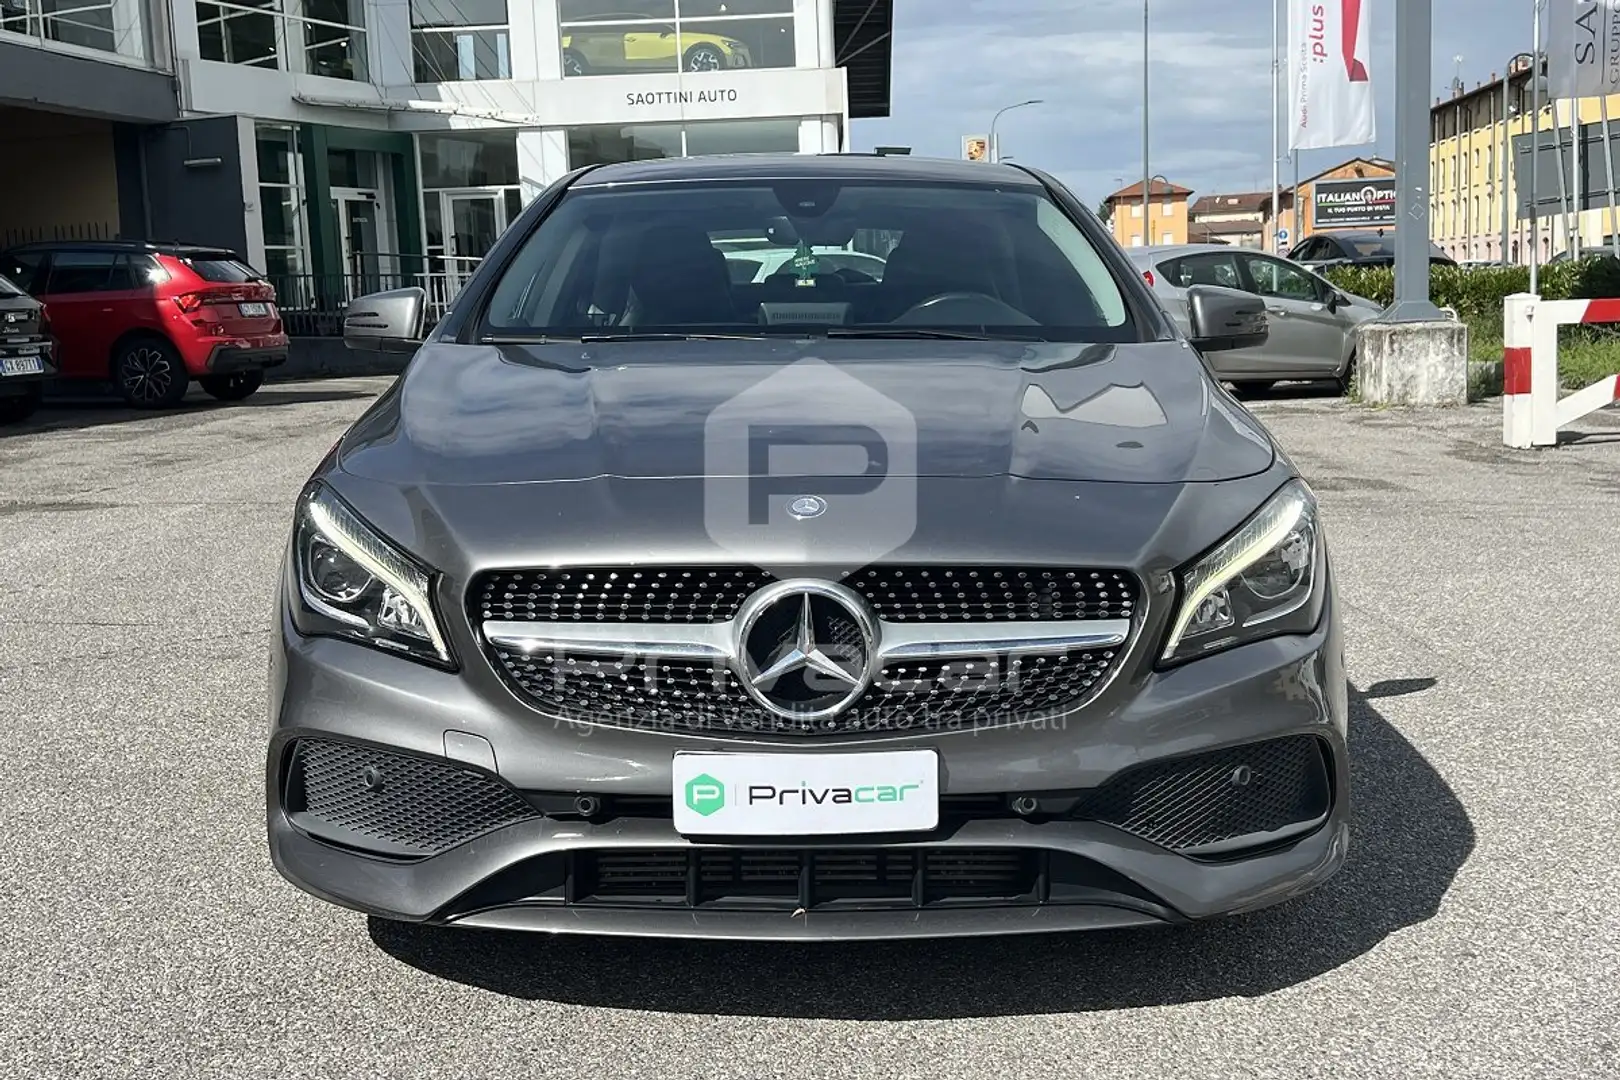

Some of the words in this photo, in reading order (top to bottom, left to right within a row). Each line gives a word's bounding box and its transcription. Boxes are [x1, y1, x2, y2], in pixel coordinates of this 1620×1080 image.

[1574, 0, 1599, 65] SA
[626, 91, 693, 106] SAOTTINI
[697, 89, 738, 103] AUTO
[749, 780, 919, 806] Privacar
